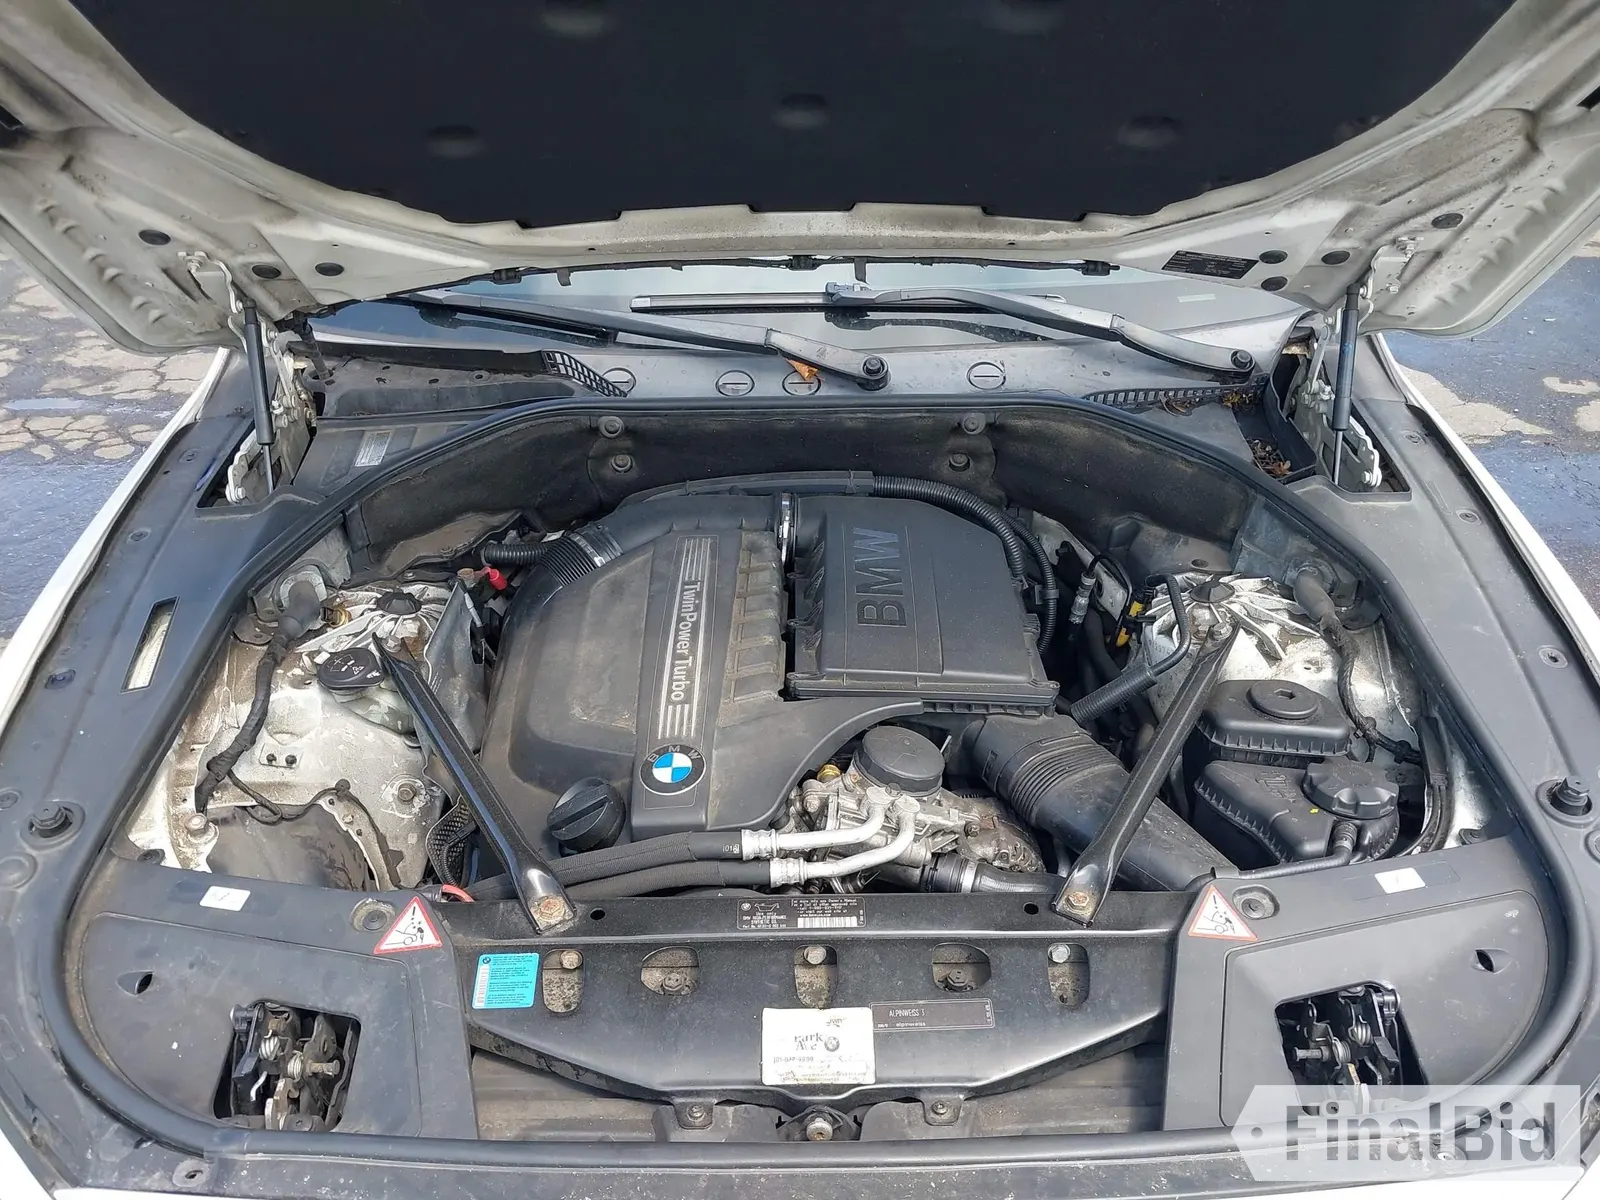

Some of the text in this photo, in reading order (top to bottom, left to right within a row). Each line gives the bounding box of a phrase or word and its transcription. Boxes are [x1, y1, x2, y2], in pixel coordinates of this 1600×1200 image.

[853, 527, 907, 628] BMW
[671, 656, 693, 701] Turbo
[648, 745, 702, 763] BMW
[889, 1008, 919, 1017] ALPINWEISS
